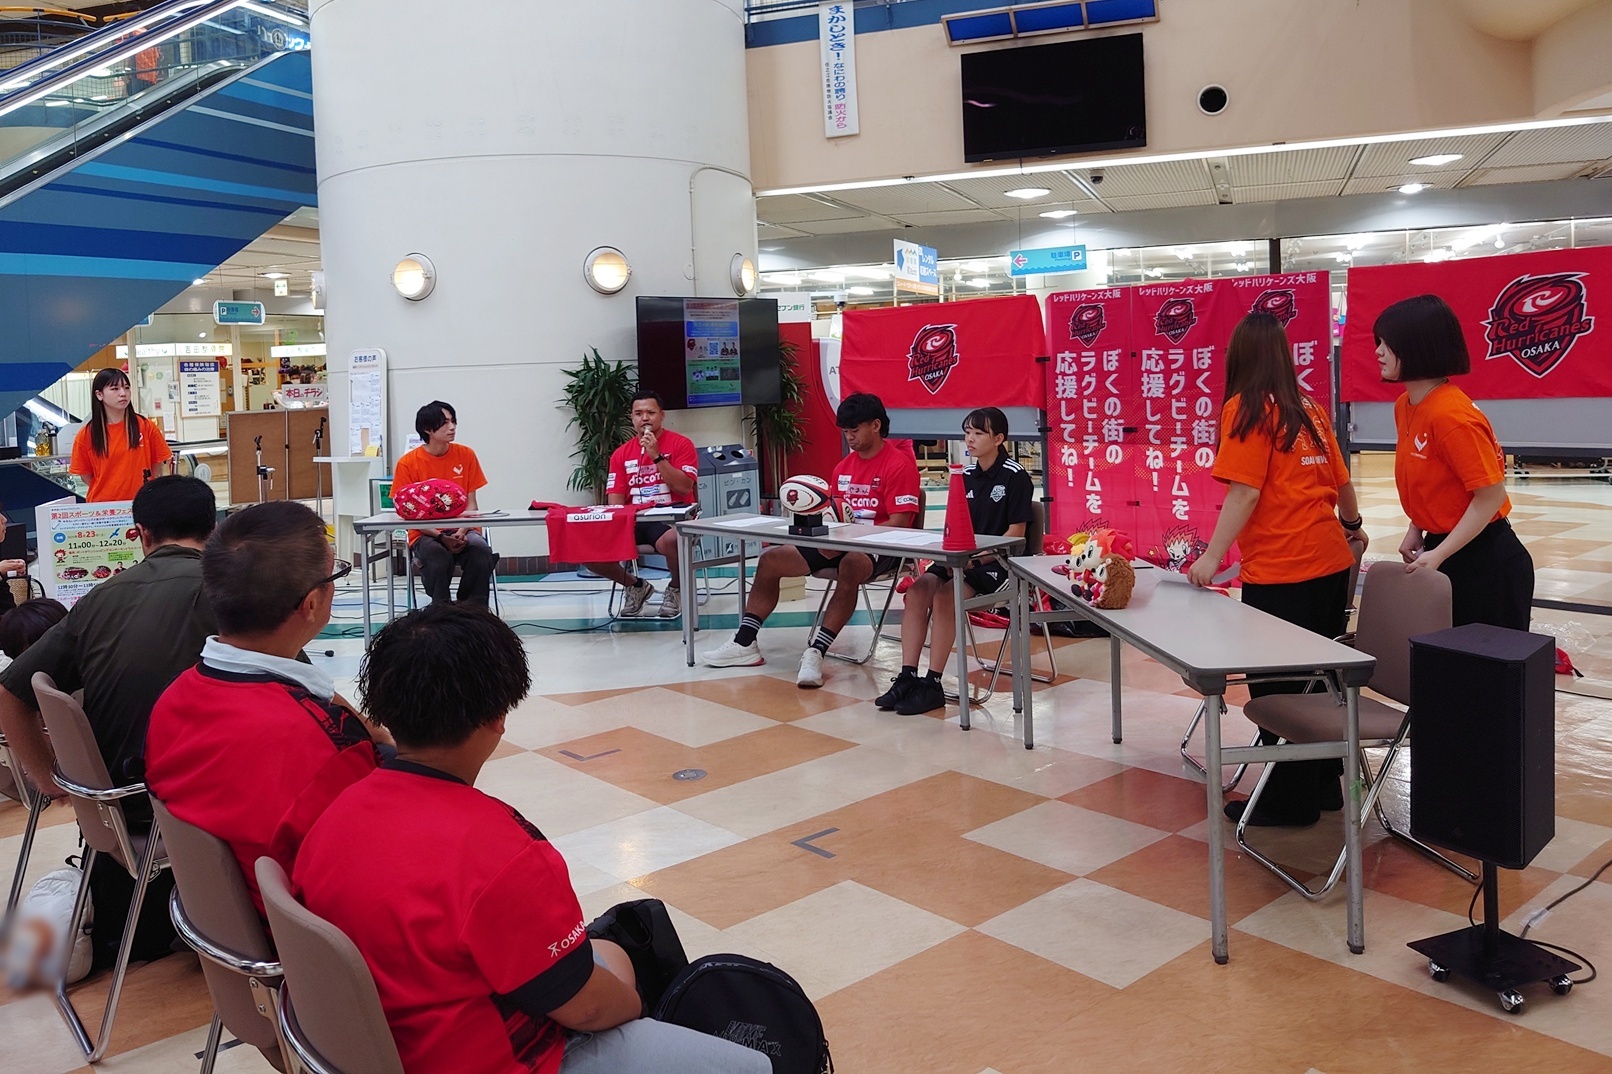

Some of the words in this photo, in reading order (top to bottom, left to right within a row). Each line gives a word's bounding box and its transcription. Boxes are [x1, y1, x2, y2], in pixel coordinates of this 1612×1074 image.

[1053, 289, 1122, 302] レッドハリケーンズ大阪
[1139, 283, 1214, 296] レッドハリケーンズ大阪
[1488, 316, 1532, 338] Red
[1492, 319, 1590, 353] Hurricanes
[910, 353, 930, 368] Red
[1521, 340, 1560, 358] OSAKA
[911, 355, 958, 376] Hurricanes
[925, 369, 944, 381] OSAKA
[286, 388, 322, 398] 本日のチラシ
[1055, 350, 1078, 487] 応援してね!
[1102, 349, 1124, 464] ぼくの街の
[1192, 346, 1216, 468] ぼくの街の
[1140, 348, 1166, 492] 応援してね!
[1080, 351, 1102, 514] ラグビーチームを
[1168, 348, 1190, 520] ラグビーチームを
[561, 921, 586, 948] OSAKA
